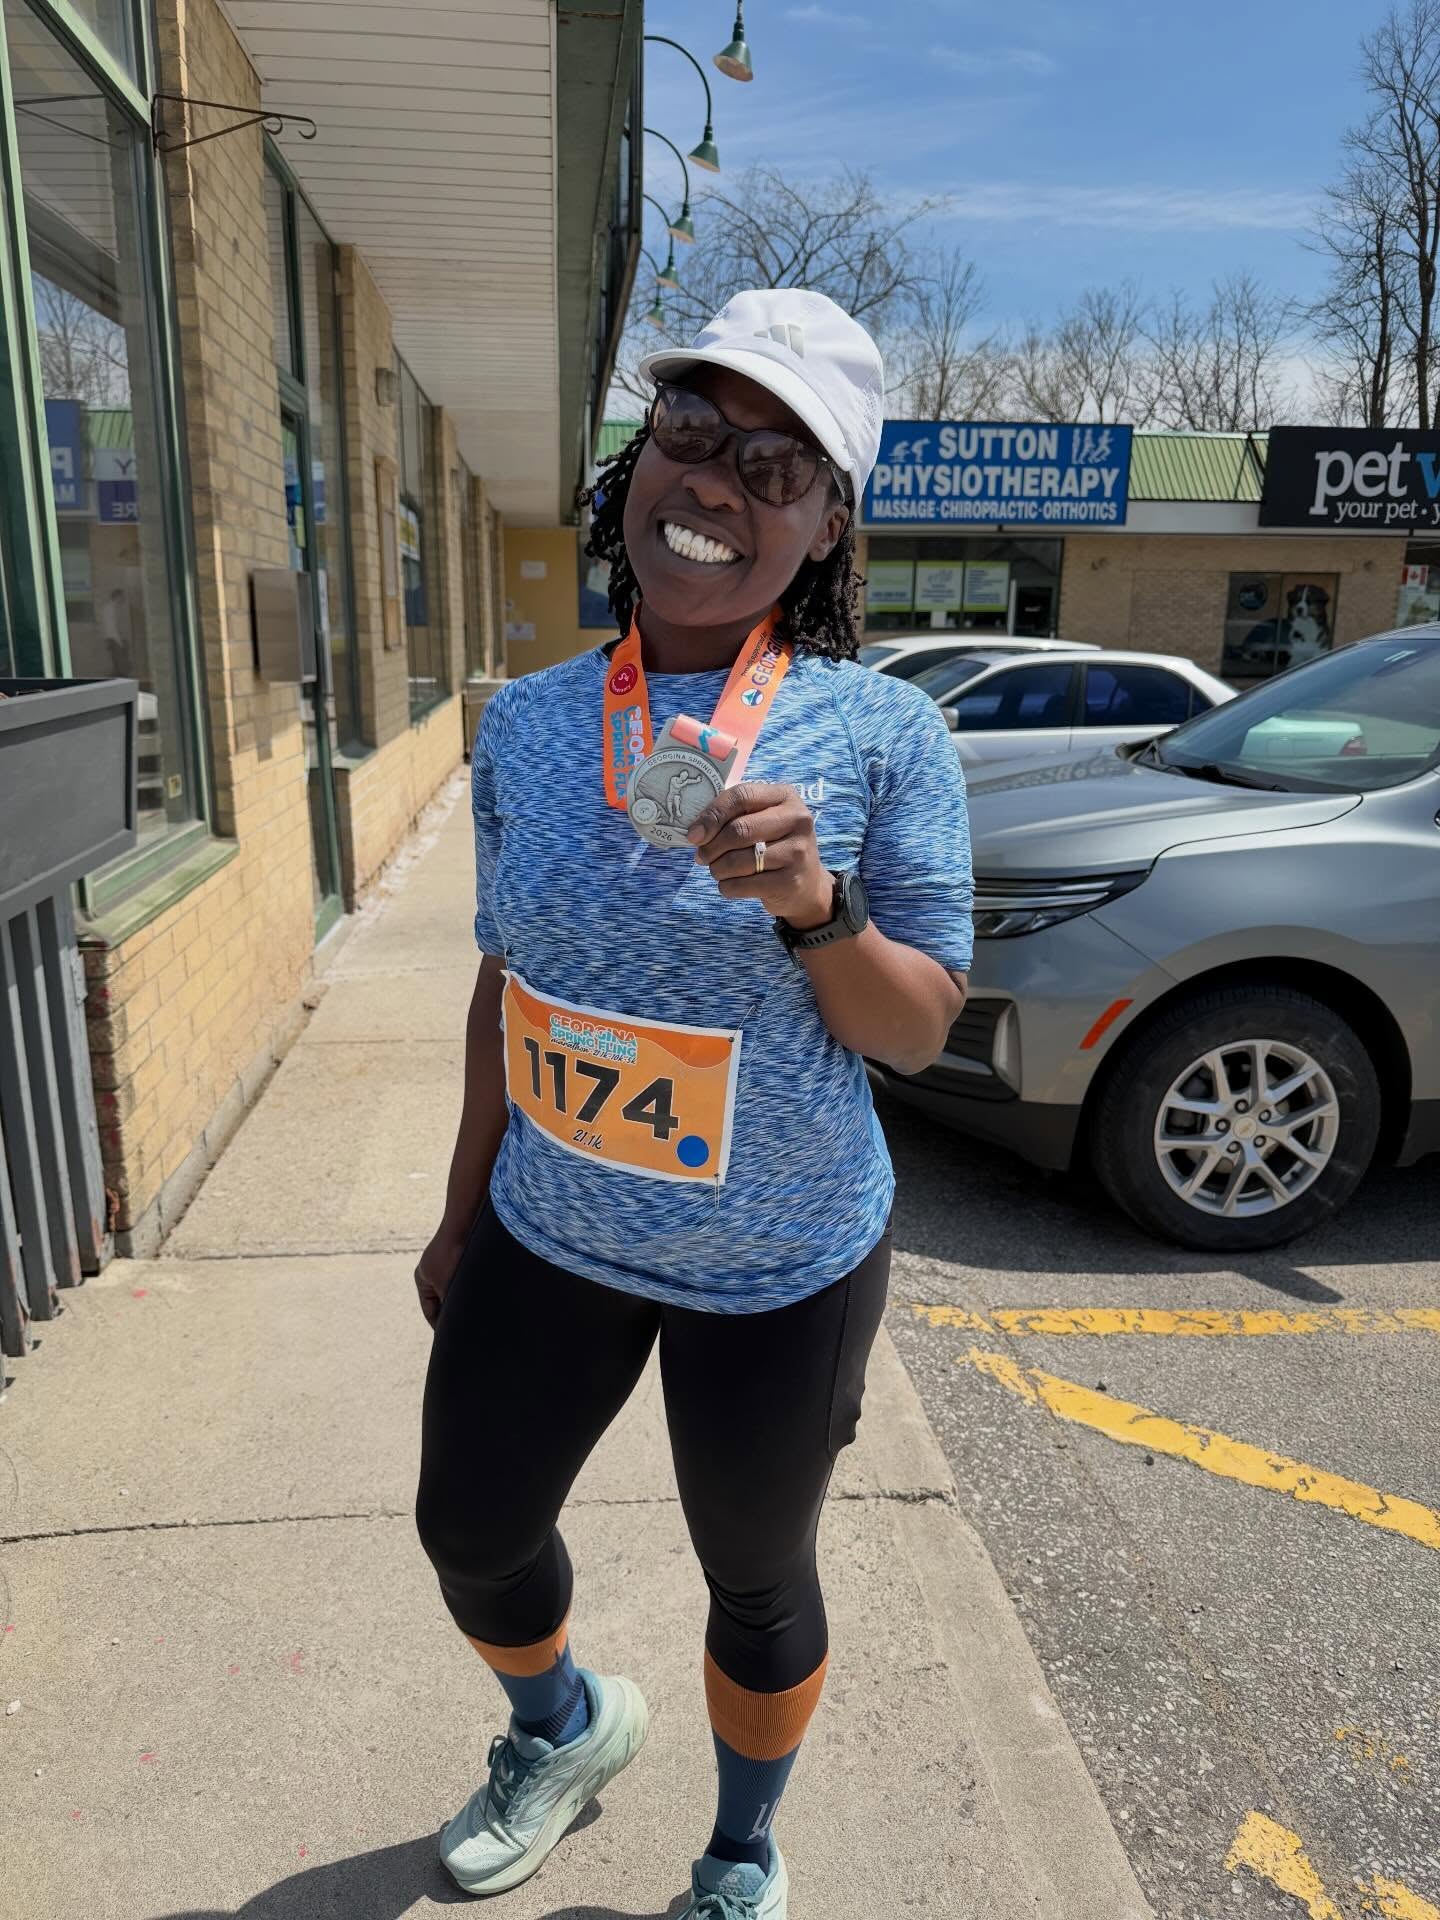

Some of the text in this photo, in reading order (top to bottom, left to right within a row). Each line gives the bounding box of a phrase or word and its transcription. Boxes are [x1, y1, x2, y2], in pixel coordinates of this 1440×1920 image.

[939, 426, 1059, 460] SUTTON
[872, 464, 1120, 498] PHYSIOTHERAPY
[1311, 442, 1411, 516] pet
[1334, 501, 1384, 523] your
[1385, 500, 1418, 524] pet
[610, 711, 626, 769] SPRING
[648, 753, 686, 767] GEORGINA
[688, 756, 713, 777] SPRING
[650, 827, 673, 842] 2026
[551, 1027, 637, 1057] SPRING FLING
[523, 1035, 680, 1141] 1174
[572, 1128, 604, 1150] 21.1k
